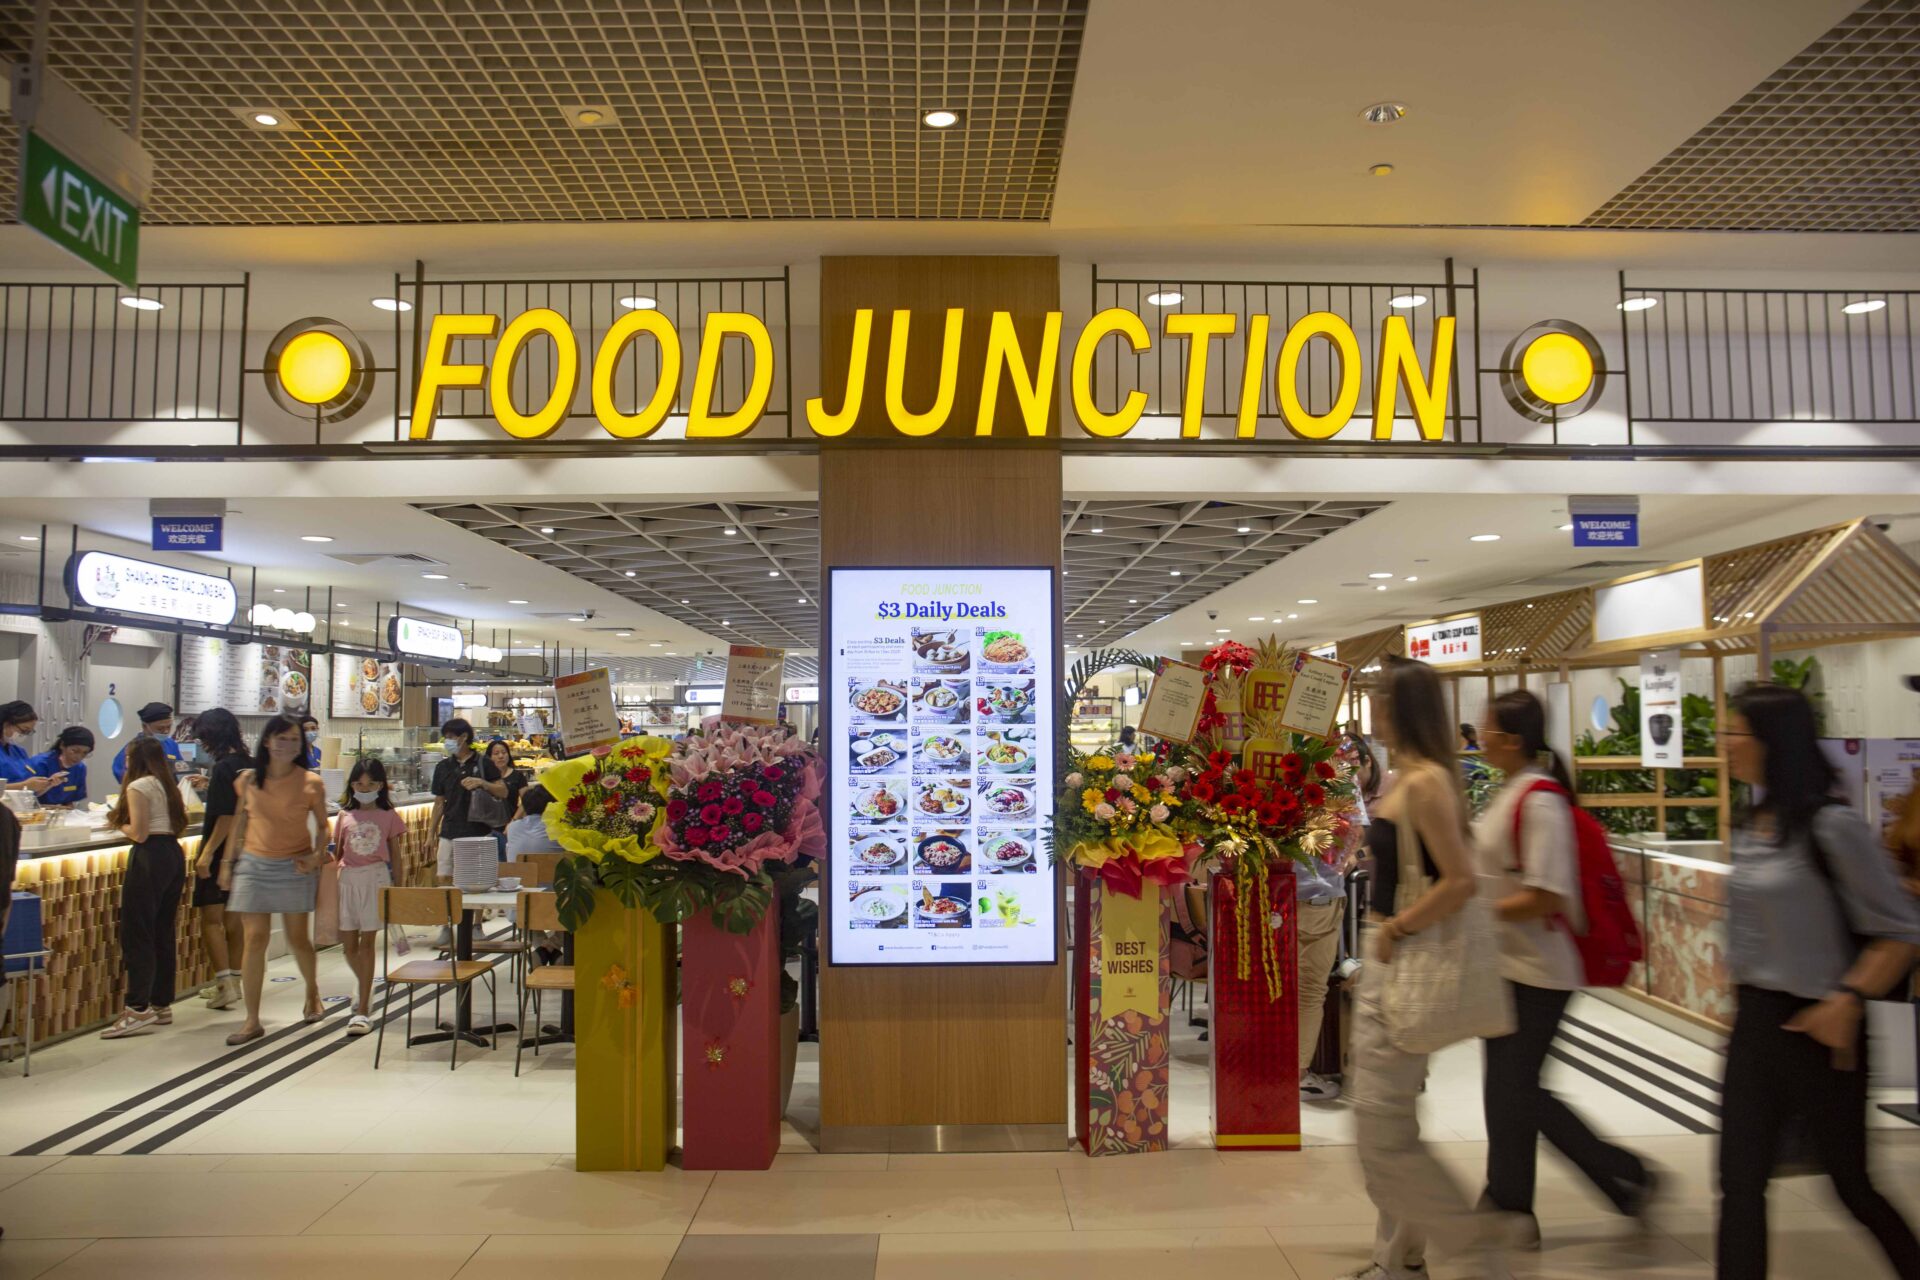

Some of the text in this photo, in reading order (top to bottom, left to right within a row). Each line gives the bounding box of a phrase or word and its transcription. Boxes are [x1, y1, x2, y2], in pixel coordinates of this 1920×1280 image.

[60, 170, 129, 265] EXIT
[409, 308, 1456, 442] FOOD JUNCTION
[160, 523, 215, 533] WELCOME!
[1579, 520, 1631, 530] WELCOME!
[168, 534, 207, 544] 欢迎光临
[900, 583, 983, 596] FOOD JUNCTION
[878, 601, 1006, 621] $3 Daily Deals
[109, 683, 116, 696] 2
[1253, 681, 1286, 712] 旺
[1252, 751, 1285, 780] 旺
[1115, 941, 1146, 955] BEST
[1107, 959, 1154, 975] WISHES
